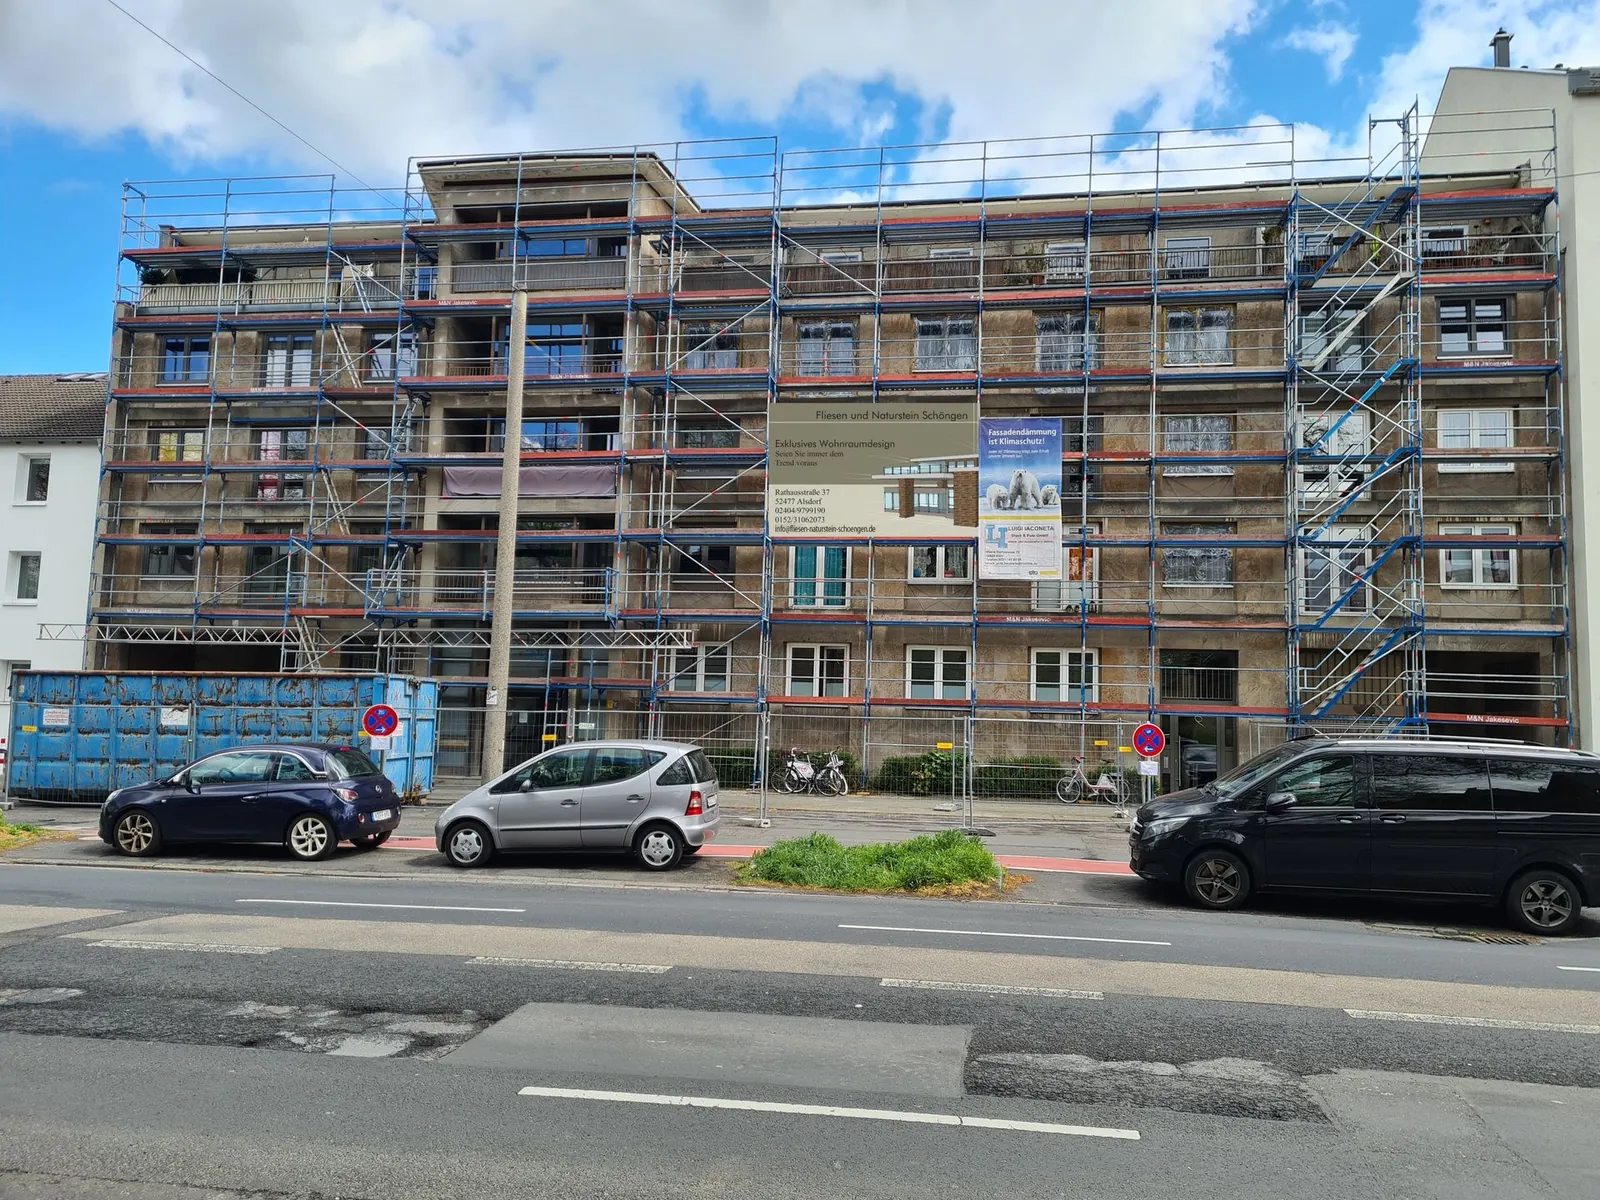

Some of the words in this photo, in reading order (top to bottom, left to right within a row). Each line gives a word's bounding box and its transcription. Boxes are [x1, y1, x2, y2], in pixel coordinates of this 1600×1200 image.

[816, 411, 848, 420] Fliesen
[851, 411, 868, 420] und
[872, 411, 919, 420] Naturstein
[922, 411, 968, 422] Schöngen
[988, 428, 1057, 436] Fassadendämmung
[775, 440, 817, 448] Exklusives
[819, 439, 895, 449] Wohnraumdesign
[774, 525, 876, 534] info@fliesen-naturstein-schoengen.de
